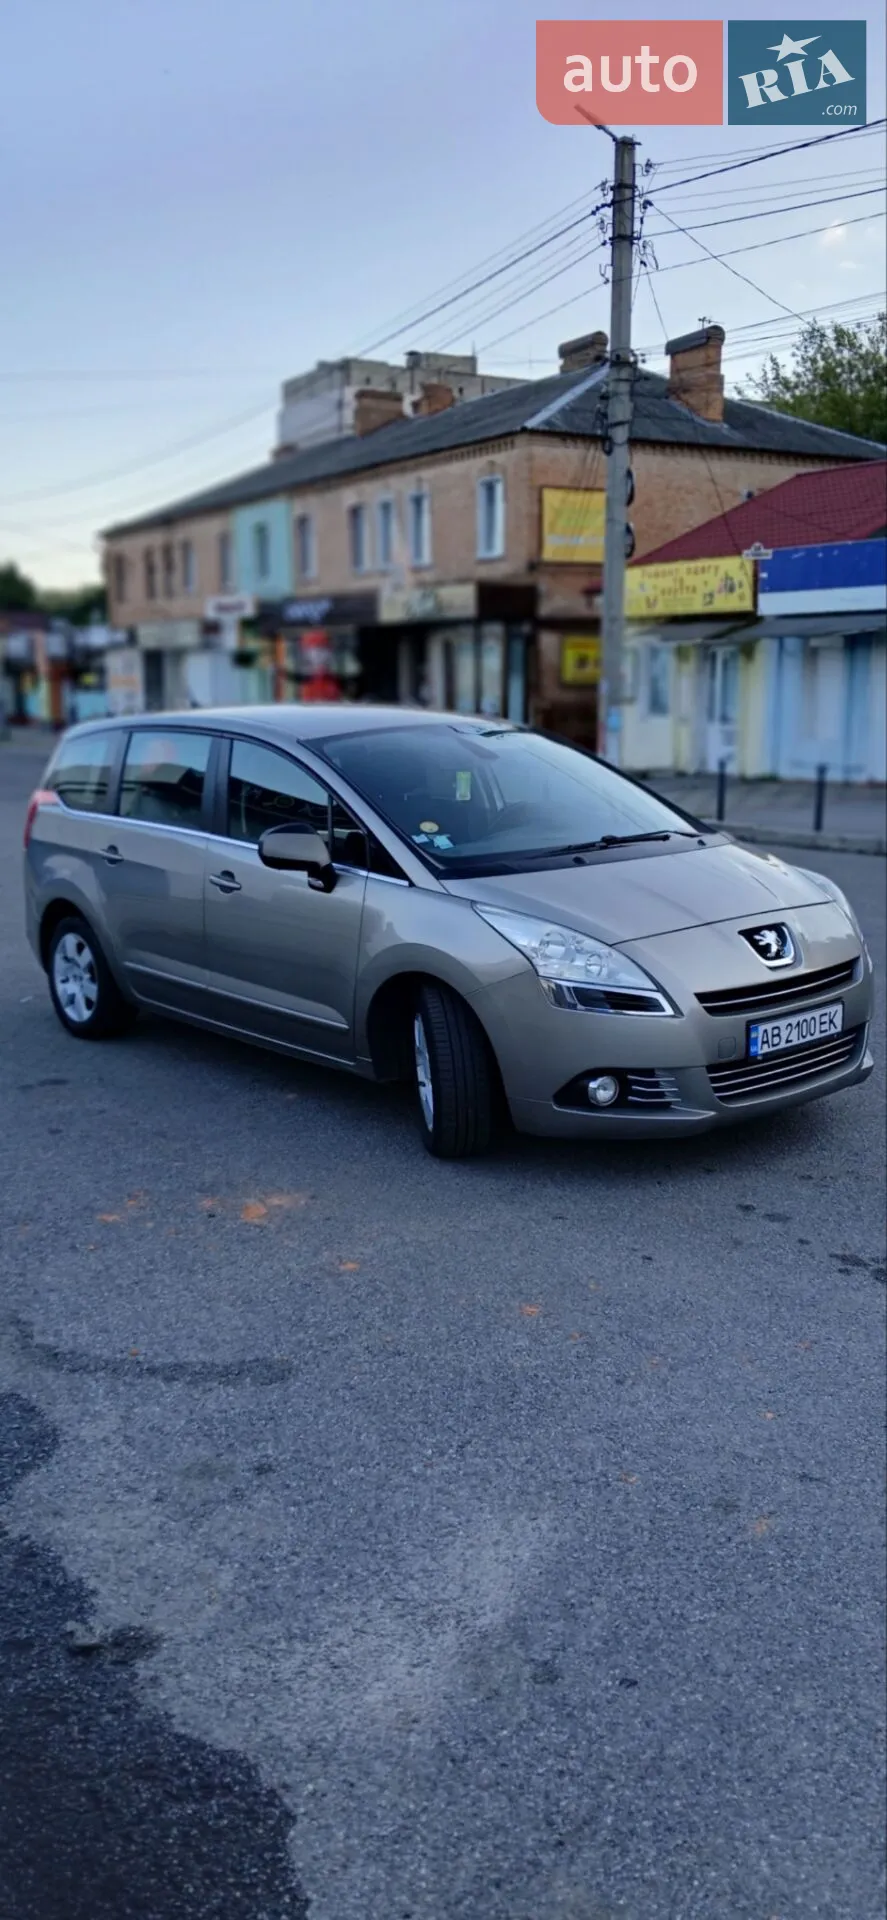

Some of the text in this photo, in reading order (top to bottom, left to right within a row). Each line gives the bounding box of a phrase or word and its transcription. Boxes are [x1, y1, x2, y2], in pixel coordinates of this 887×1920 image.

[760, 1009, 838, 1051] AB 2100 EK
